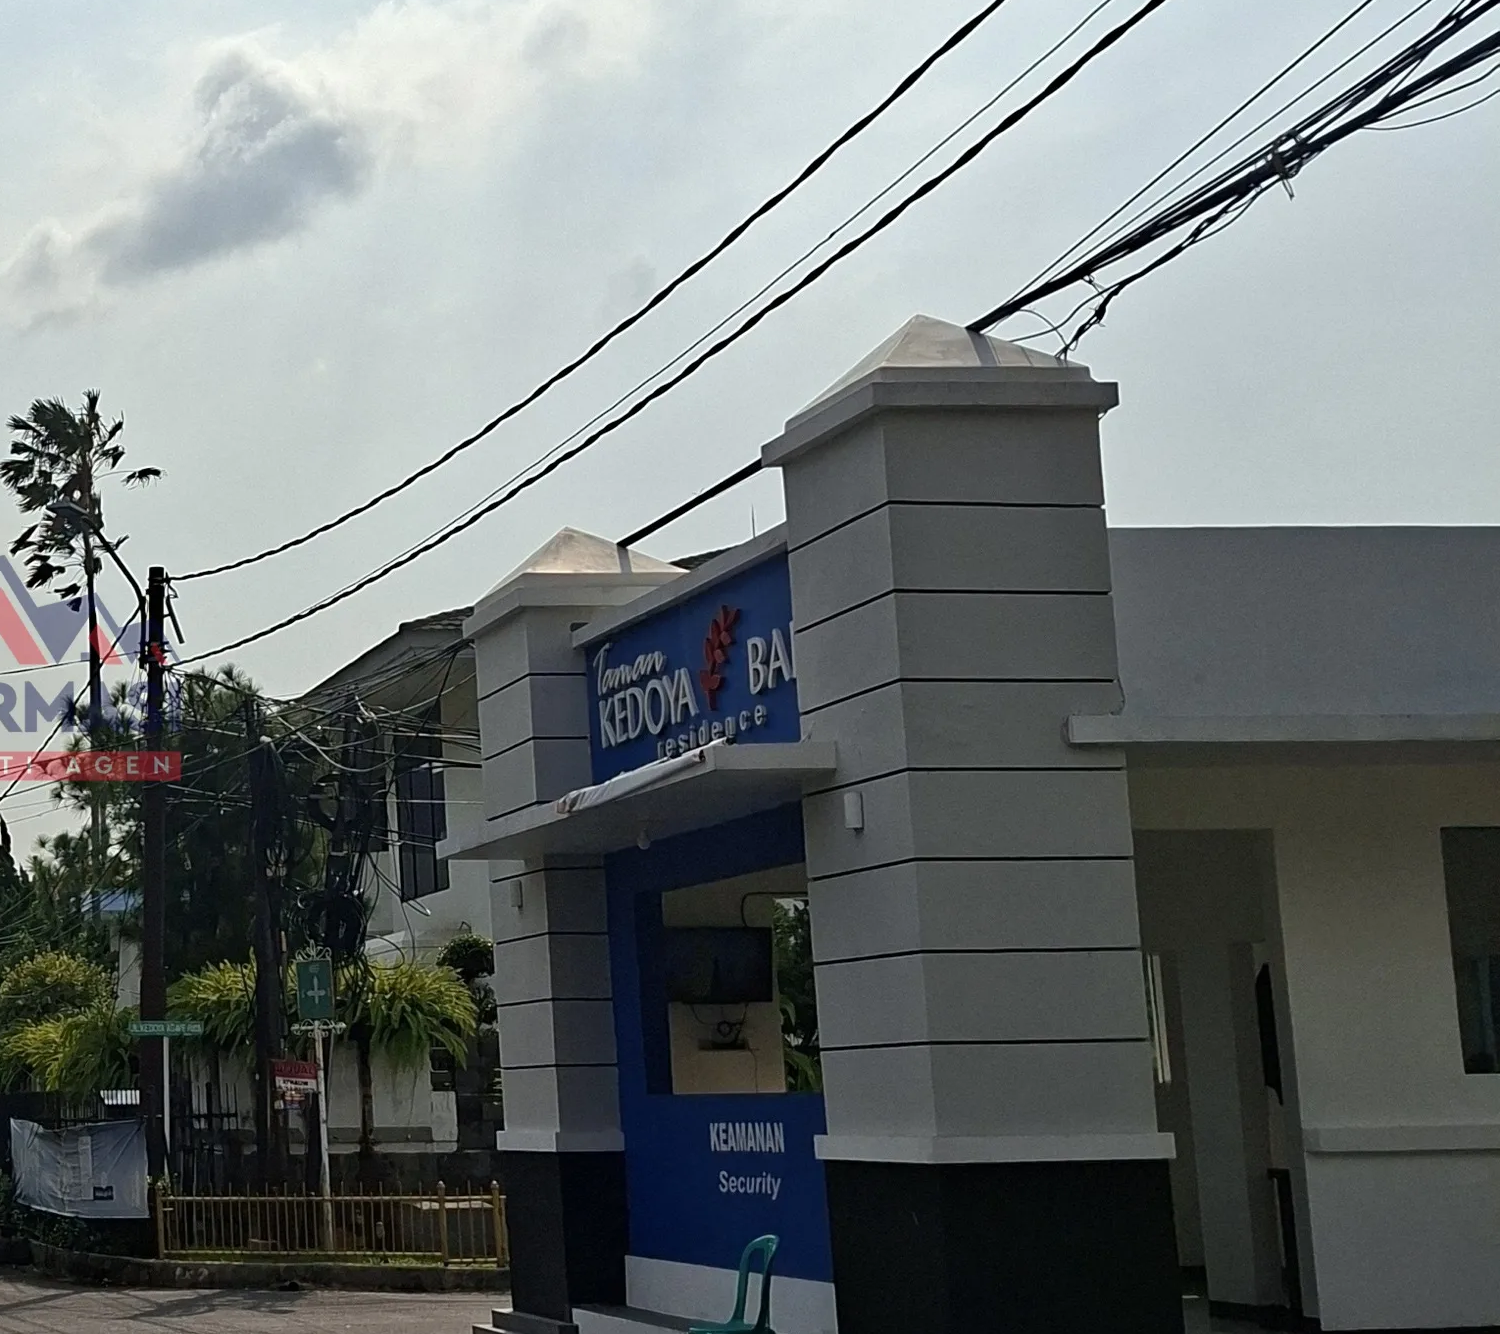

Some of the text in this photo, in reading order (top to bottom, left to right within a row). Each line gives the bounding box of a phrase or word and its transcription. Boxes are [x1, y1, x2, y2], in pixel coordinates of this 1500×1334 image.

[593, 642, 666, 696] Taman
[599, 620, 796, 749] KEDOYA BA
[710, 1122, 785, 1153] KEAMANAN
[719, 1171, 781, 1200] Security
